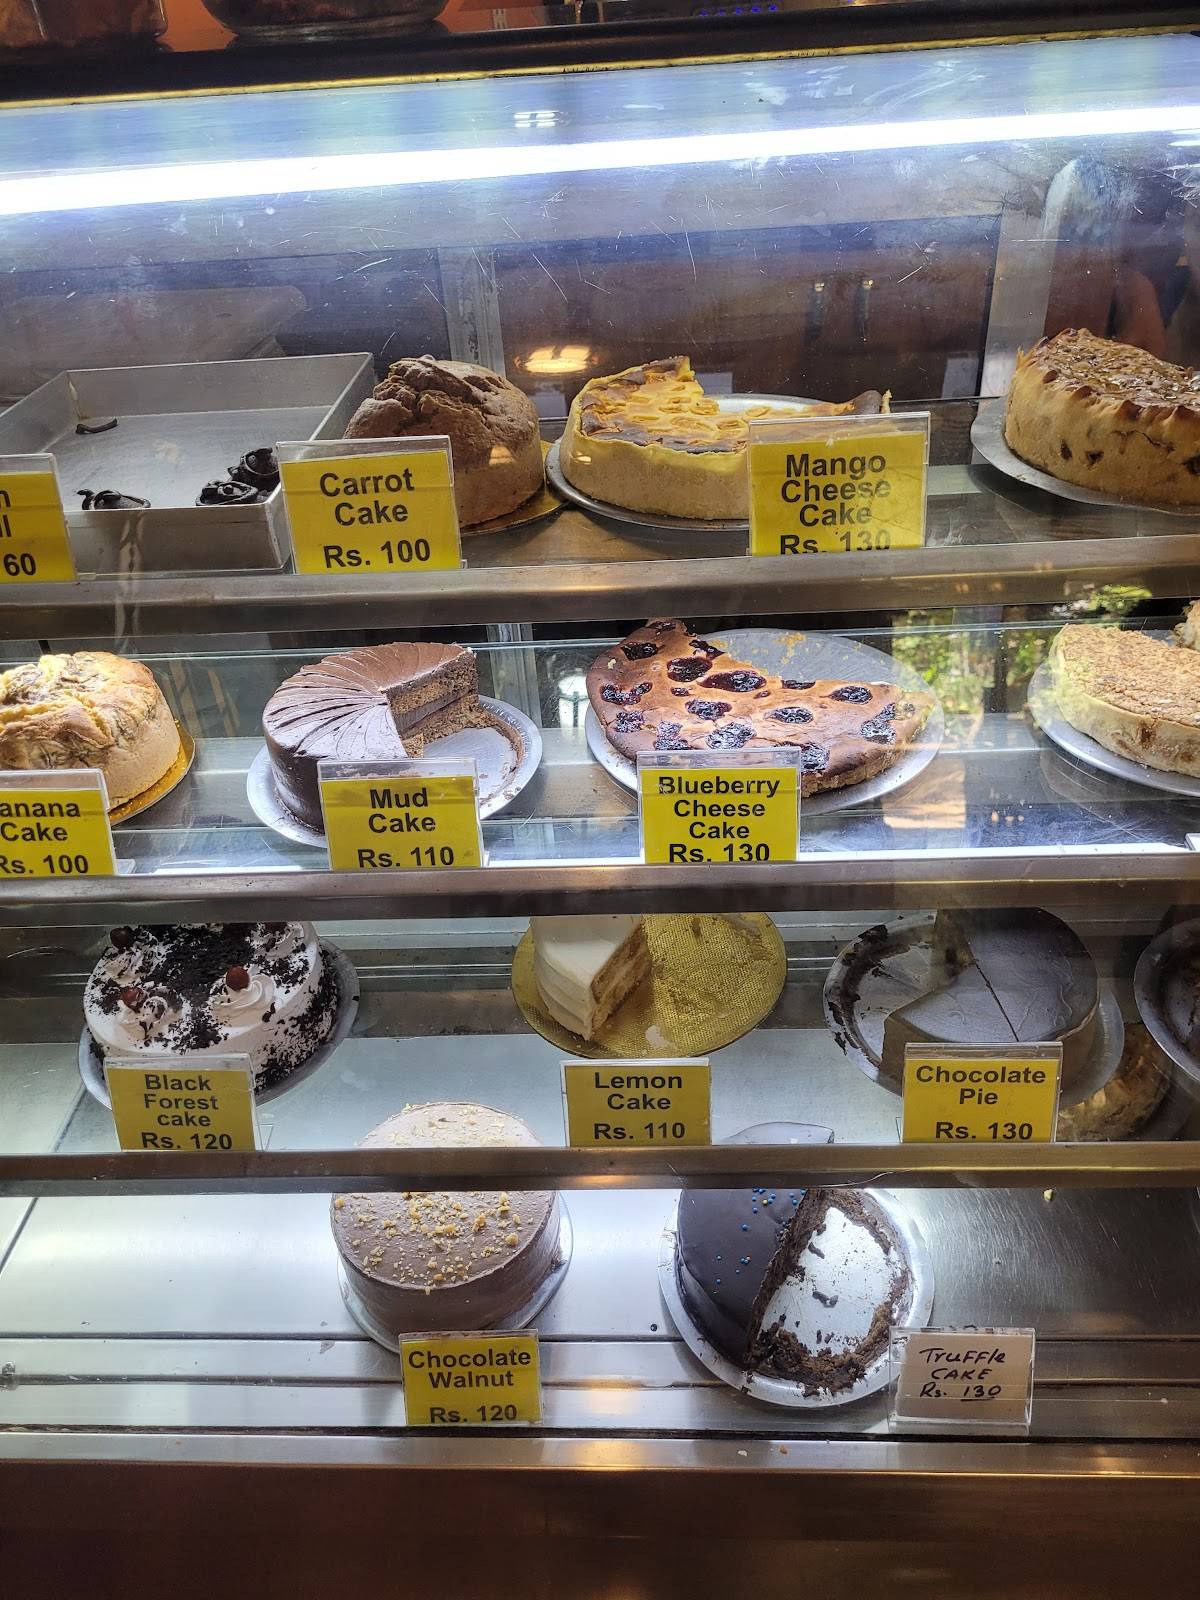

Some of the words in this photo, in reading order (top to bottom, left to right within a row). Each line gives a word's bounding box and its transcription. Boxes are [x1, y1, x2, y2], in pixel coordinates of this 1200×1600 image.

[786, 453, 886, 480] Mango
[319, 468, 415, 498] Carrot
[781, 479, 891, 503] Cheese
[335, 500, 408, 527] Cake
[800, 502, 872, 527] Cake
[780, 534, 827, 555] Rs.
[839, 529, 891, 552] 130
[323, 544, 371, 568] Rs.
[380, 538, 430, 564] 100
[4, 553, 36, 576] 60
[659, 776, 780, 798] Blueberry
[369, 787, 428, 809] Mud
[0, 802, 80, 817] anana
[674, 799, 766, 817] Cheese
[0, 822, 68, 842] Cake
[368, 813, 436, 833] Cake
[689, 821, 750, 839] Cake
[357, 848, 400, 868] Rs.
[410, 846, 455, 866] 110
[669, 843, 712, 863] Rs.
[723, 843, 770, 862] 130
[43, 855, 89, 874] 100
[144, 1074, 212, 1091] Black
[594, 1072, 682, 1089] Lemon
[916, 1065, 1046, 1084] Chocolate
[144, 1093, 218, 1110] Forest
[607, 1093, 671, 1110] Cake
[959, 1088, 998, 1105] Pie
[157, 1111, 211, 1127] cake
[594, 1123, 634, 1140] Rs.
[644, 1122, 685, 1139] 110
[935, 1122, 977, 1139] Rs.
[988, 1122, 1033, 1140] 130
[141, 1132, 181, 1149] Rs.
[190, 1133, 233, 1150] 120
[408, 1348, 531, 1368] Chocolate
[428, 1370, 514, 1388] Walnut
[931, 1368, 993, 1380] CAKE
[920, 1381, 947, 1398] Rs.
[962, 1385, 1002, 1399] 130
[430, 1407, 468, 1423] Rs.
[477, 1404, 517, 1422] 120
